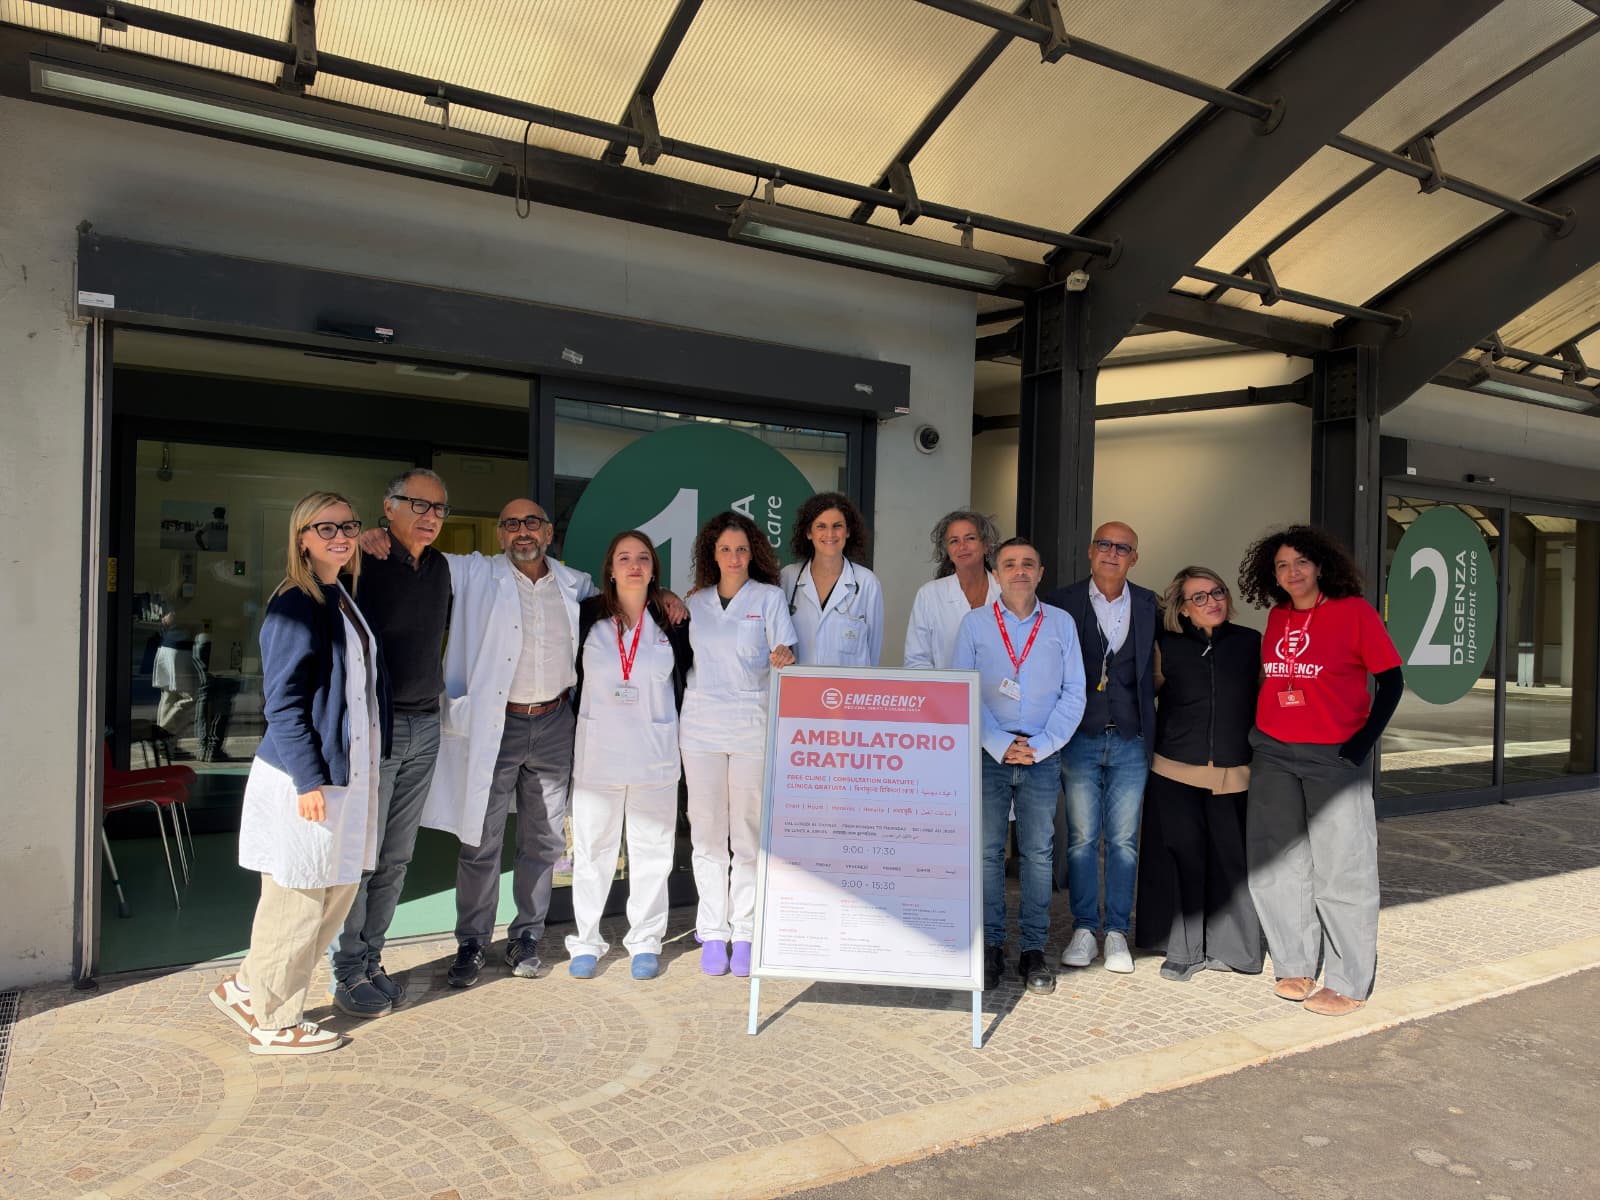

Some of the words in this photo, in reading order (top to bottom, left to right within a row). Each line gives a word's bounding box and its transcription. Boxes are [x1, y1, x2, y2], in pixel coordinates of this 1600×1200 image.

[1470, 550, 1478, 585] care
[1407, 547, 1451, 666] 2
[1453, 550, 1467, 665] DEGENZA
[1466, 590, 1477, 664] inpatient
[844, 693, 926, 708] EMERGENCY
[790, 729, 956, 751] AMBULATORIO
[790, 751, 904, 771] GRATUITO
[842, 845, 864, 854] 9:00
[872, 846, 896, 856] 17:30
[841, 879, 863, 889] 9:00
[871, 881, 895, 890] 15:30
